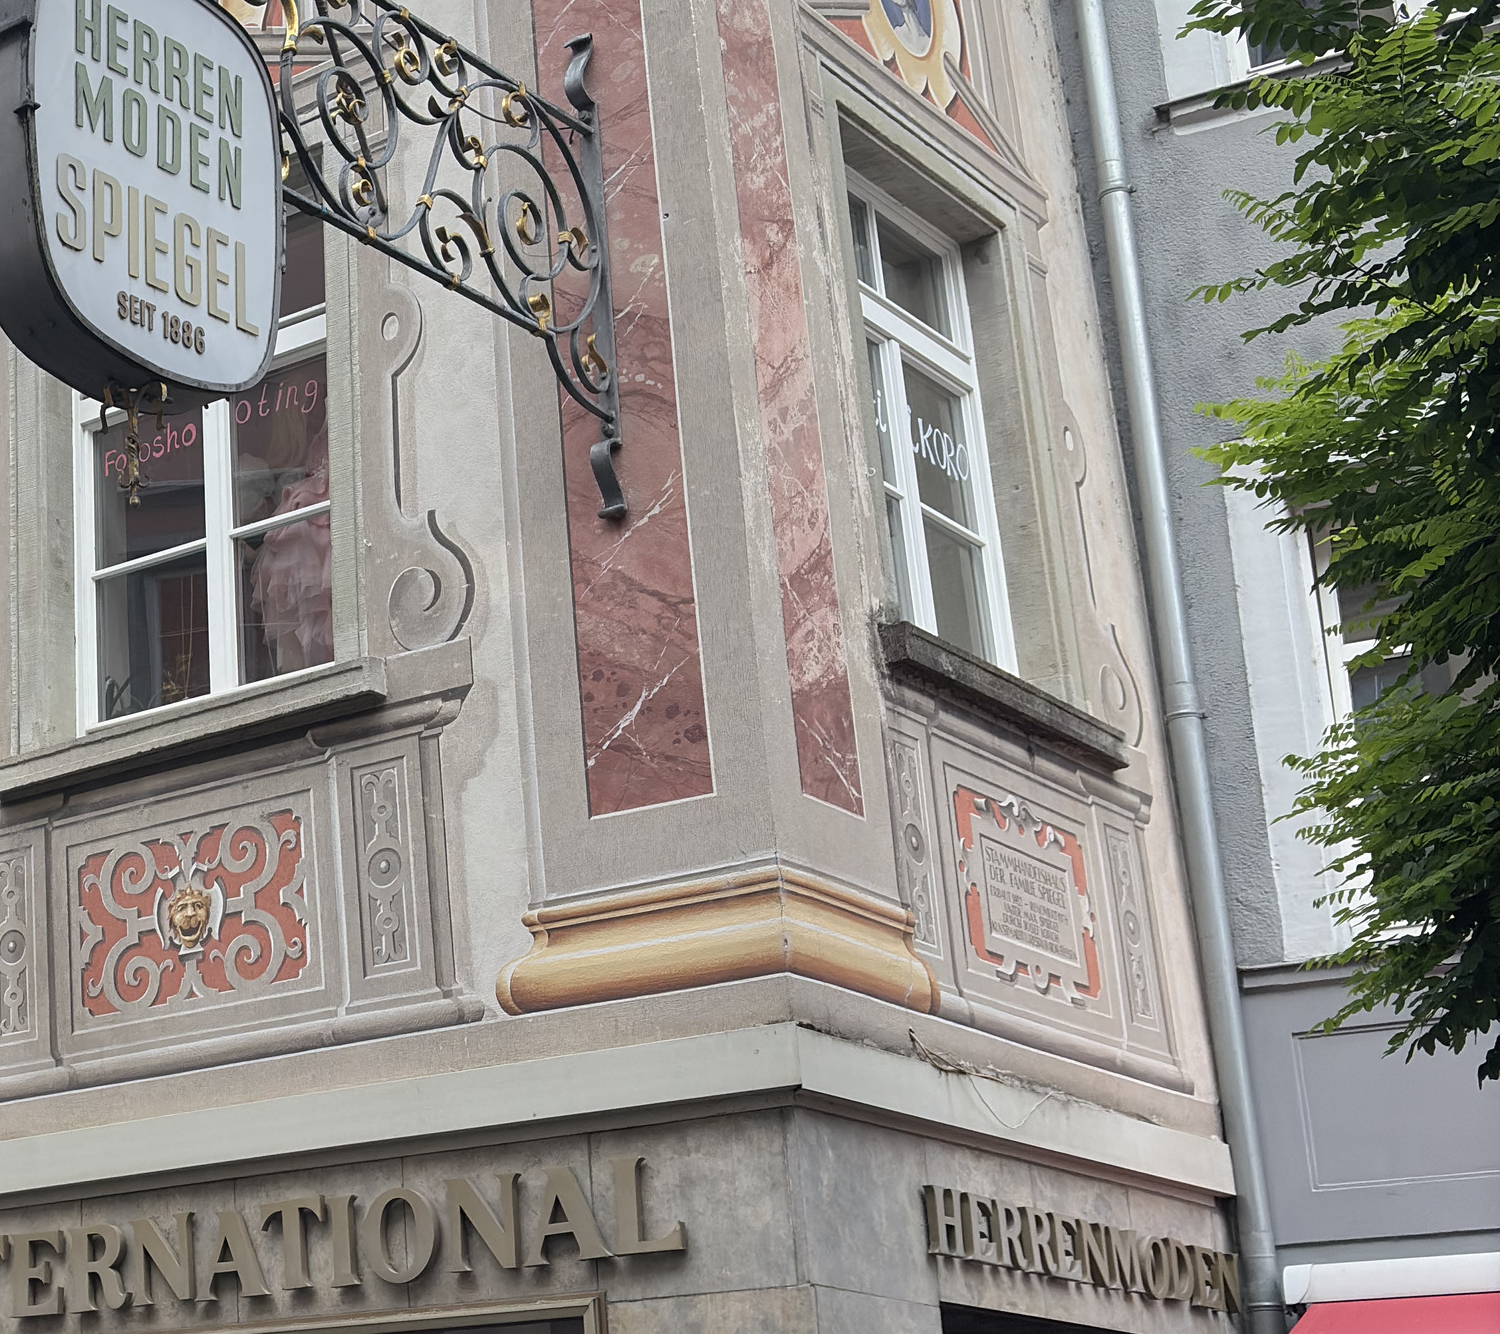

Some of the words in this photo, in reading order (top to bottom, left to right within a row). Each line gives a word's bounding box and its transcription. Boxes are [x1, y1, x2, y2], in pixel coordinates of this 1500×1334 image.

[75, 60, 243, 211] MODEN
[54, 151, 260, 337] SPIEGEL
[116, 290, 158, 332] SEIT
[161, 308, 206, 356] 1886
[104, 380, 318, 478] Fooshooting
[989, 864, 1006, 884] DER
[1037, 884, 1067, 909] SPIEGEL
[923, 1184, 1241, 1313] HERRENMODEN
